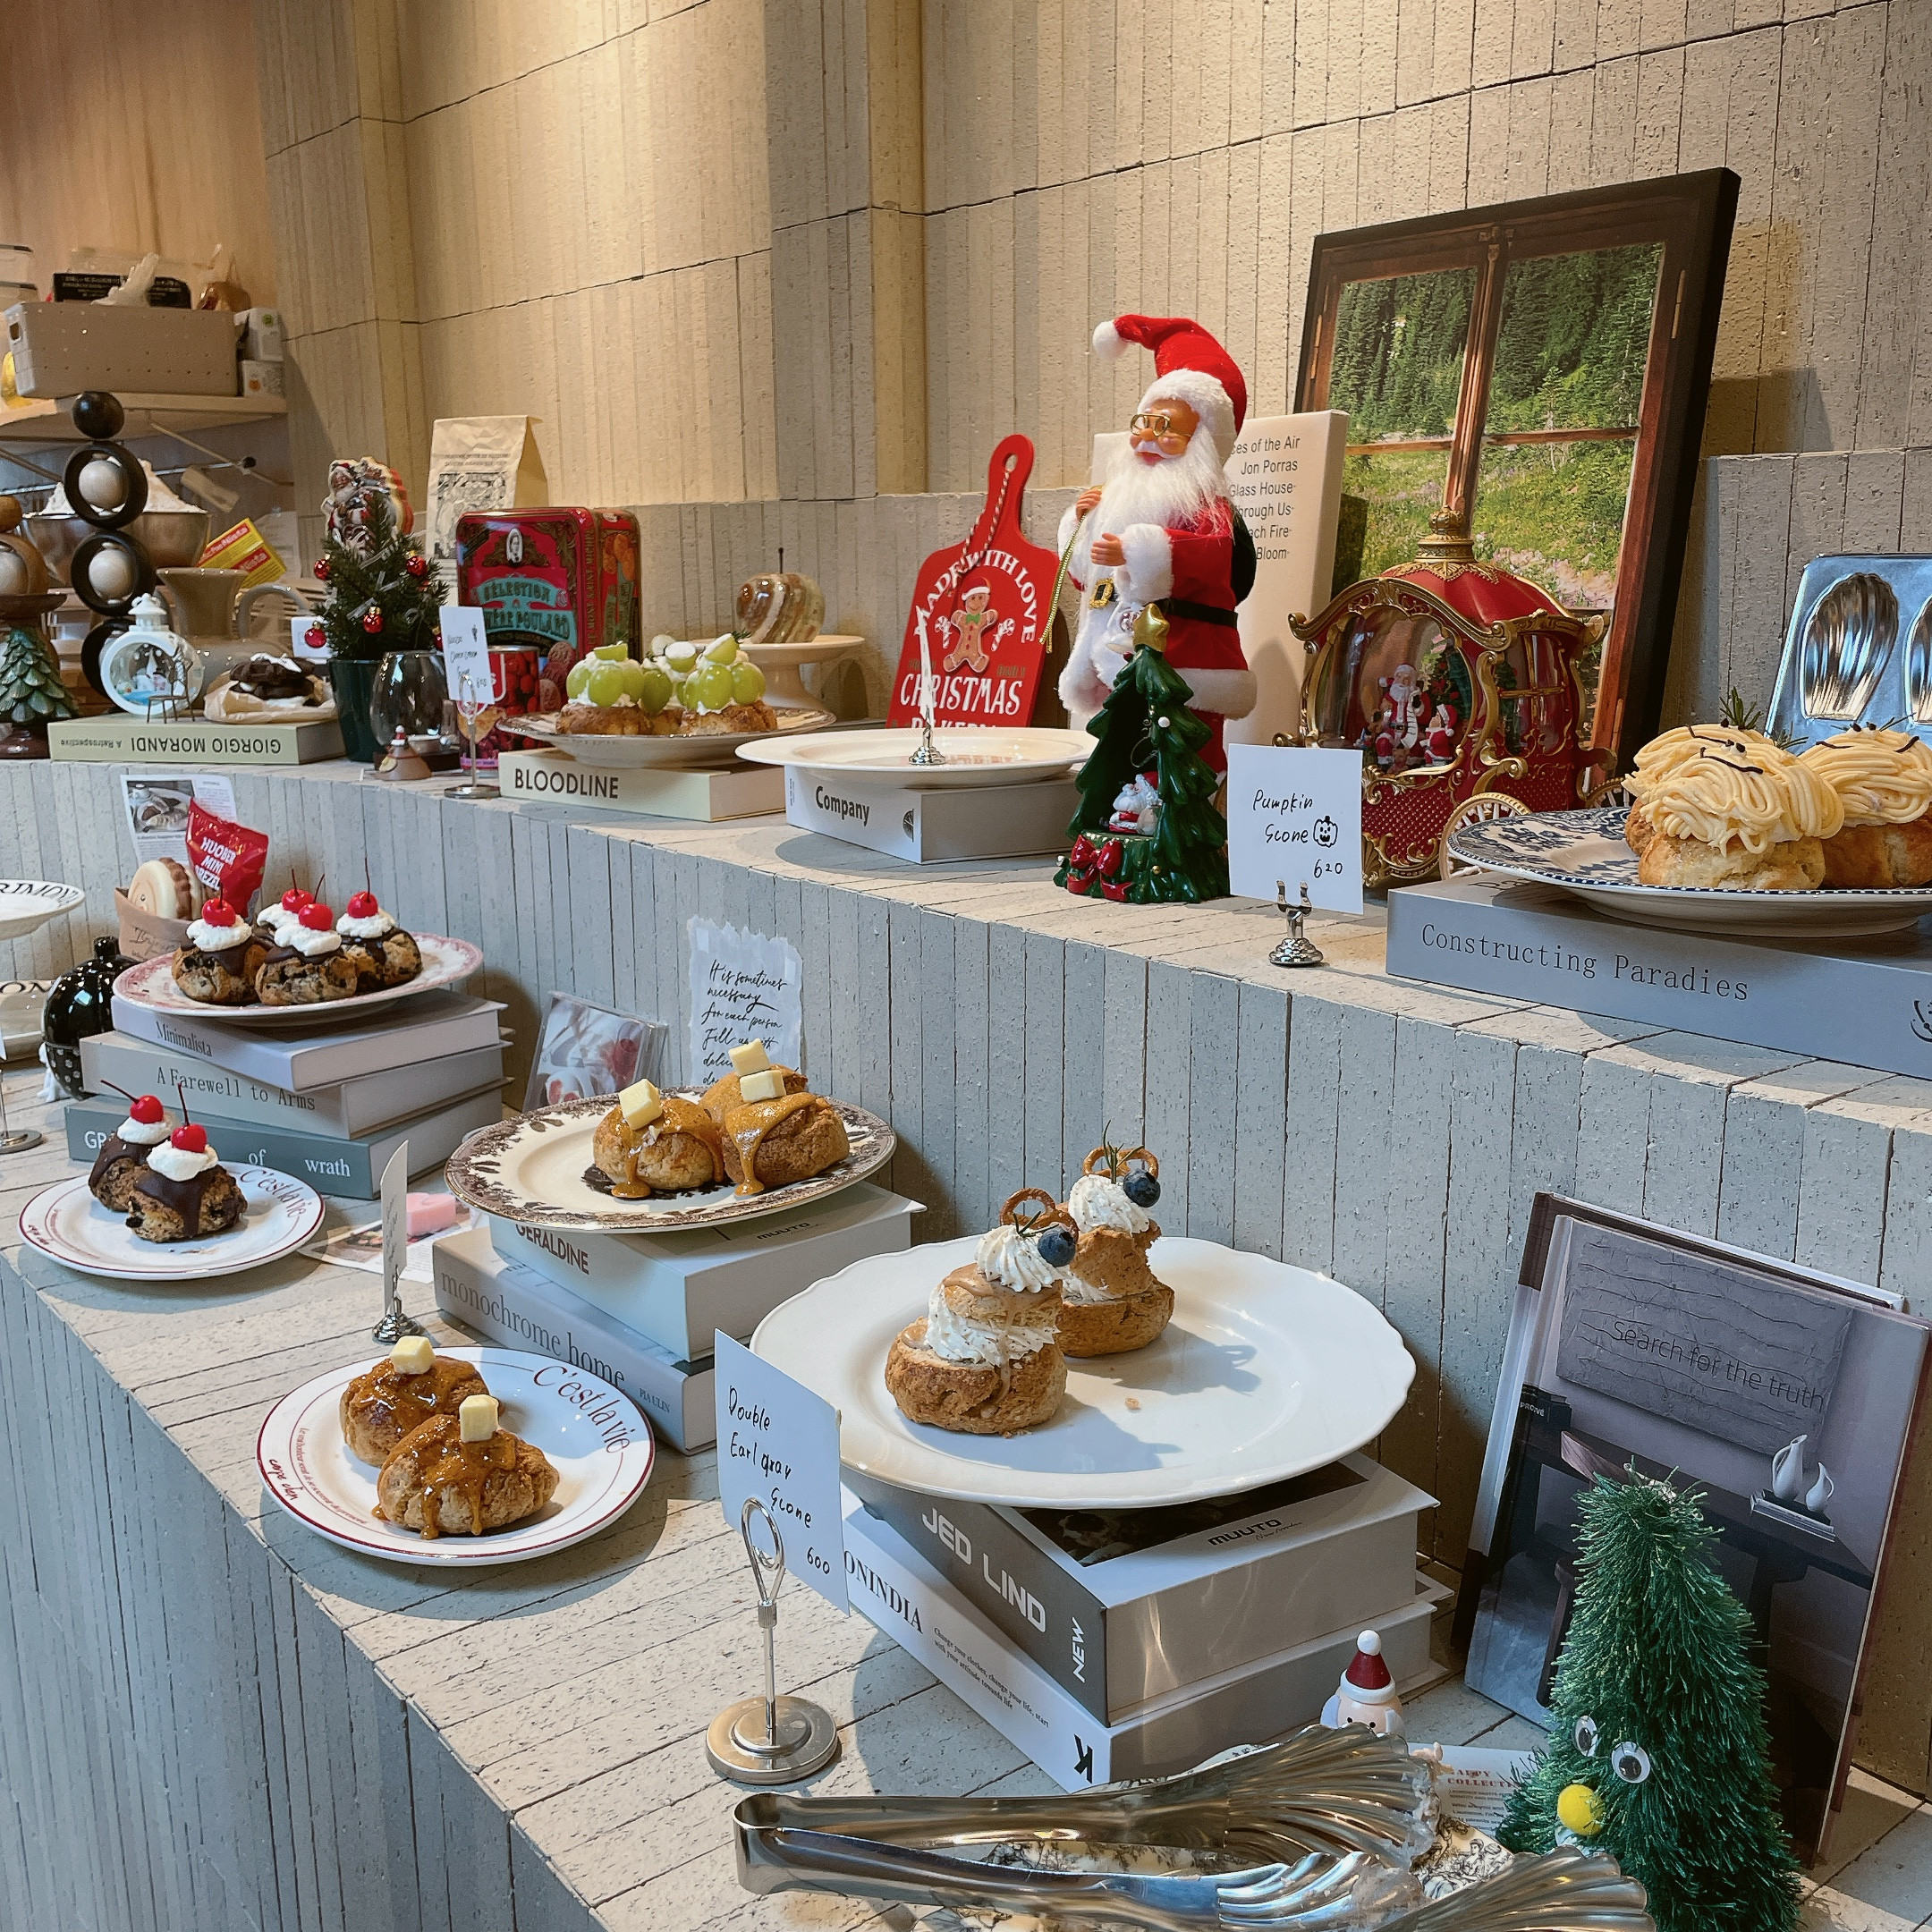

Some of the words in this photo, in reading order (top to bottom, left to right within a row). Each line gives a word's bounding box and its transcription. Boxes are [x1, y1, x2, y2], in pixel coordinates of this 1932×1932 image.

[1251, 438, 1262, 453] of
[1265, 438, 1281, 451] the
[1284, 436, 1301, 449] Air
[1241, 462, 1259, 475] Jon
[1263, 460, 1298, 473] Porras
[1014, 567, 1038, 643] LOVE
[900, 673, 1023, 716] CHRISTMAS
[131, 737, 206, 753] MORANDI
[212, 738, 282, 754] GIORGIO
[515, 768, 619, 799] BLOODLINE
[816, 785, 869, 826] Company
[1252, 789, 1313, 816] Pumpkin
[200, 836, 237, 866] HUOBER
[1265, 824, 1309, 843] Scone
[1314, 859, 1343, 878] 620
[1421, 924, 1597, 979] Constructing
[1614, 954, 1748, 1001] Paradies
[734, 970, 787, 991] sometimes
[701, 1001, 724, 1025] for
[748, 1016, 783, 1031] person
[707, 987, 780, 1013] necessary
[156, 1021, 213, 1057] Minimalista
[157, 1066, 166, 1084] A
[170, 1068, 242, 1098] Farewell
[250, 1085, 268, 1103] to
[278, 1088, 316, 1111] Arms
[248, 1149, 267, 1165] of
[305, 1157, 352, 1177] wrath
[515, 1224, 590, 1275] GERALDINE
[441, 1272, 562, 1356] monochrome
[567, 1331, 625, 1387] home
[1614, 1321, 1682, 1363] Search
[1689, 1346, 1722, 1375] for
[1726, 1360, 1762, 1390] the
[1769, 1375, 1824, 1412] truth
[534, 1365, 606, 1410] C'est
[588, 1399, 621, 1426] la
[728, 1385, 771, 1431] Double
[601, 1420, 636, 1453] vie
[730, 1431, 757, 1466] Earl
[770, 1487, 812, 1529] Scone
[806, 1546, 831, 1575] 600
[921, 1507, 973, 1565] JED
[983, 1553, 1046, 1633] LIND
[1072, 1616, 1086, 1683] NEW
[934, 1640, 946, 1654] with
[946, 1651, 958, 1664] your
[960, 1661, 980, 1682] attitude
[981, 1680, 1003, 1701] towards
[934, 1628, 953, 1648] Change
[954, 1646, 966, 1658] your
[988, 1674, 1008, 1693] change
[1009, 1691, 1021, 1704] your
[1036, 1713, 1049, 1728] start
